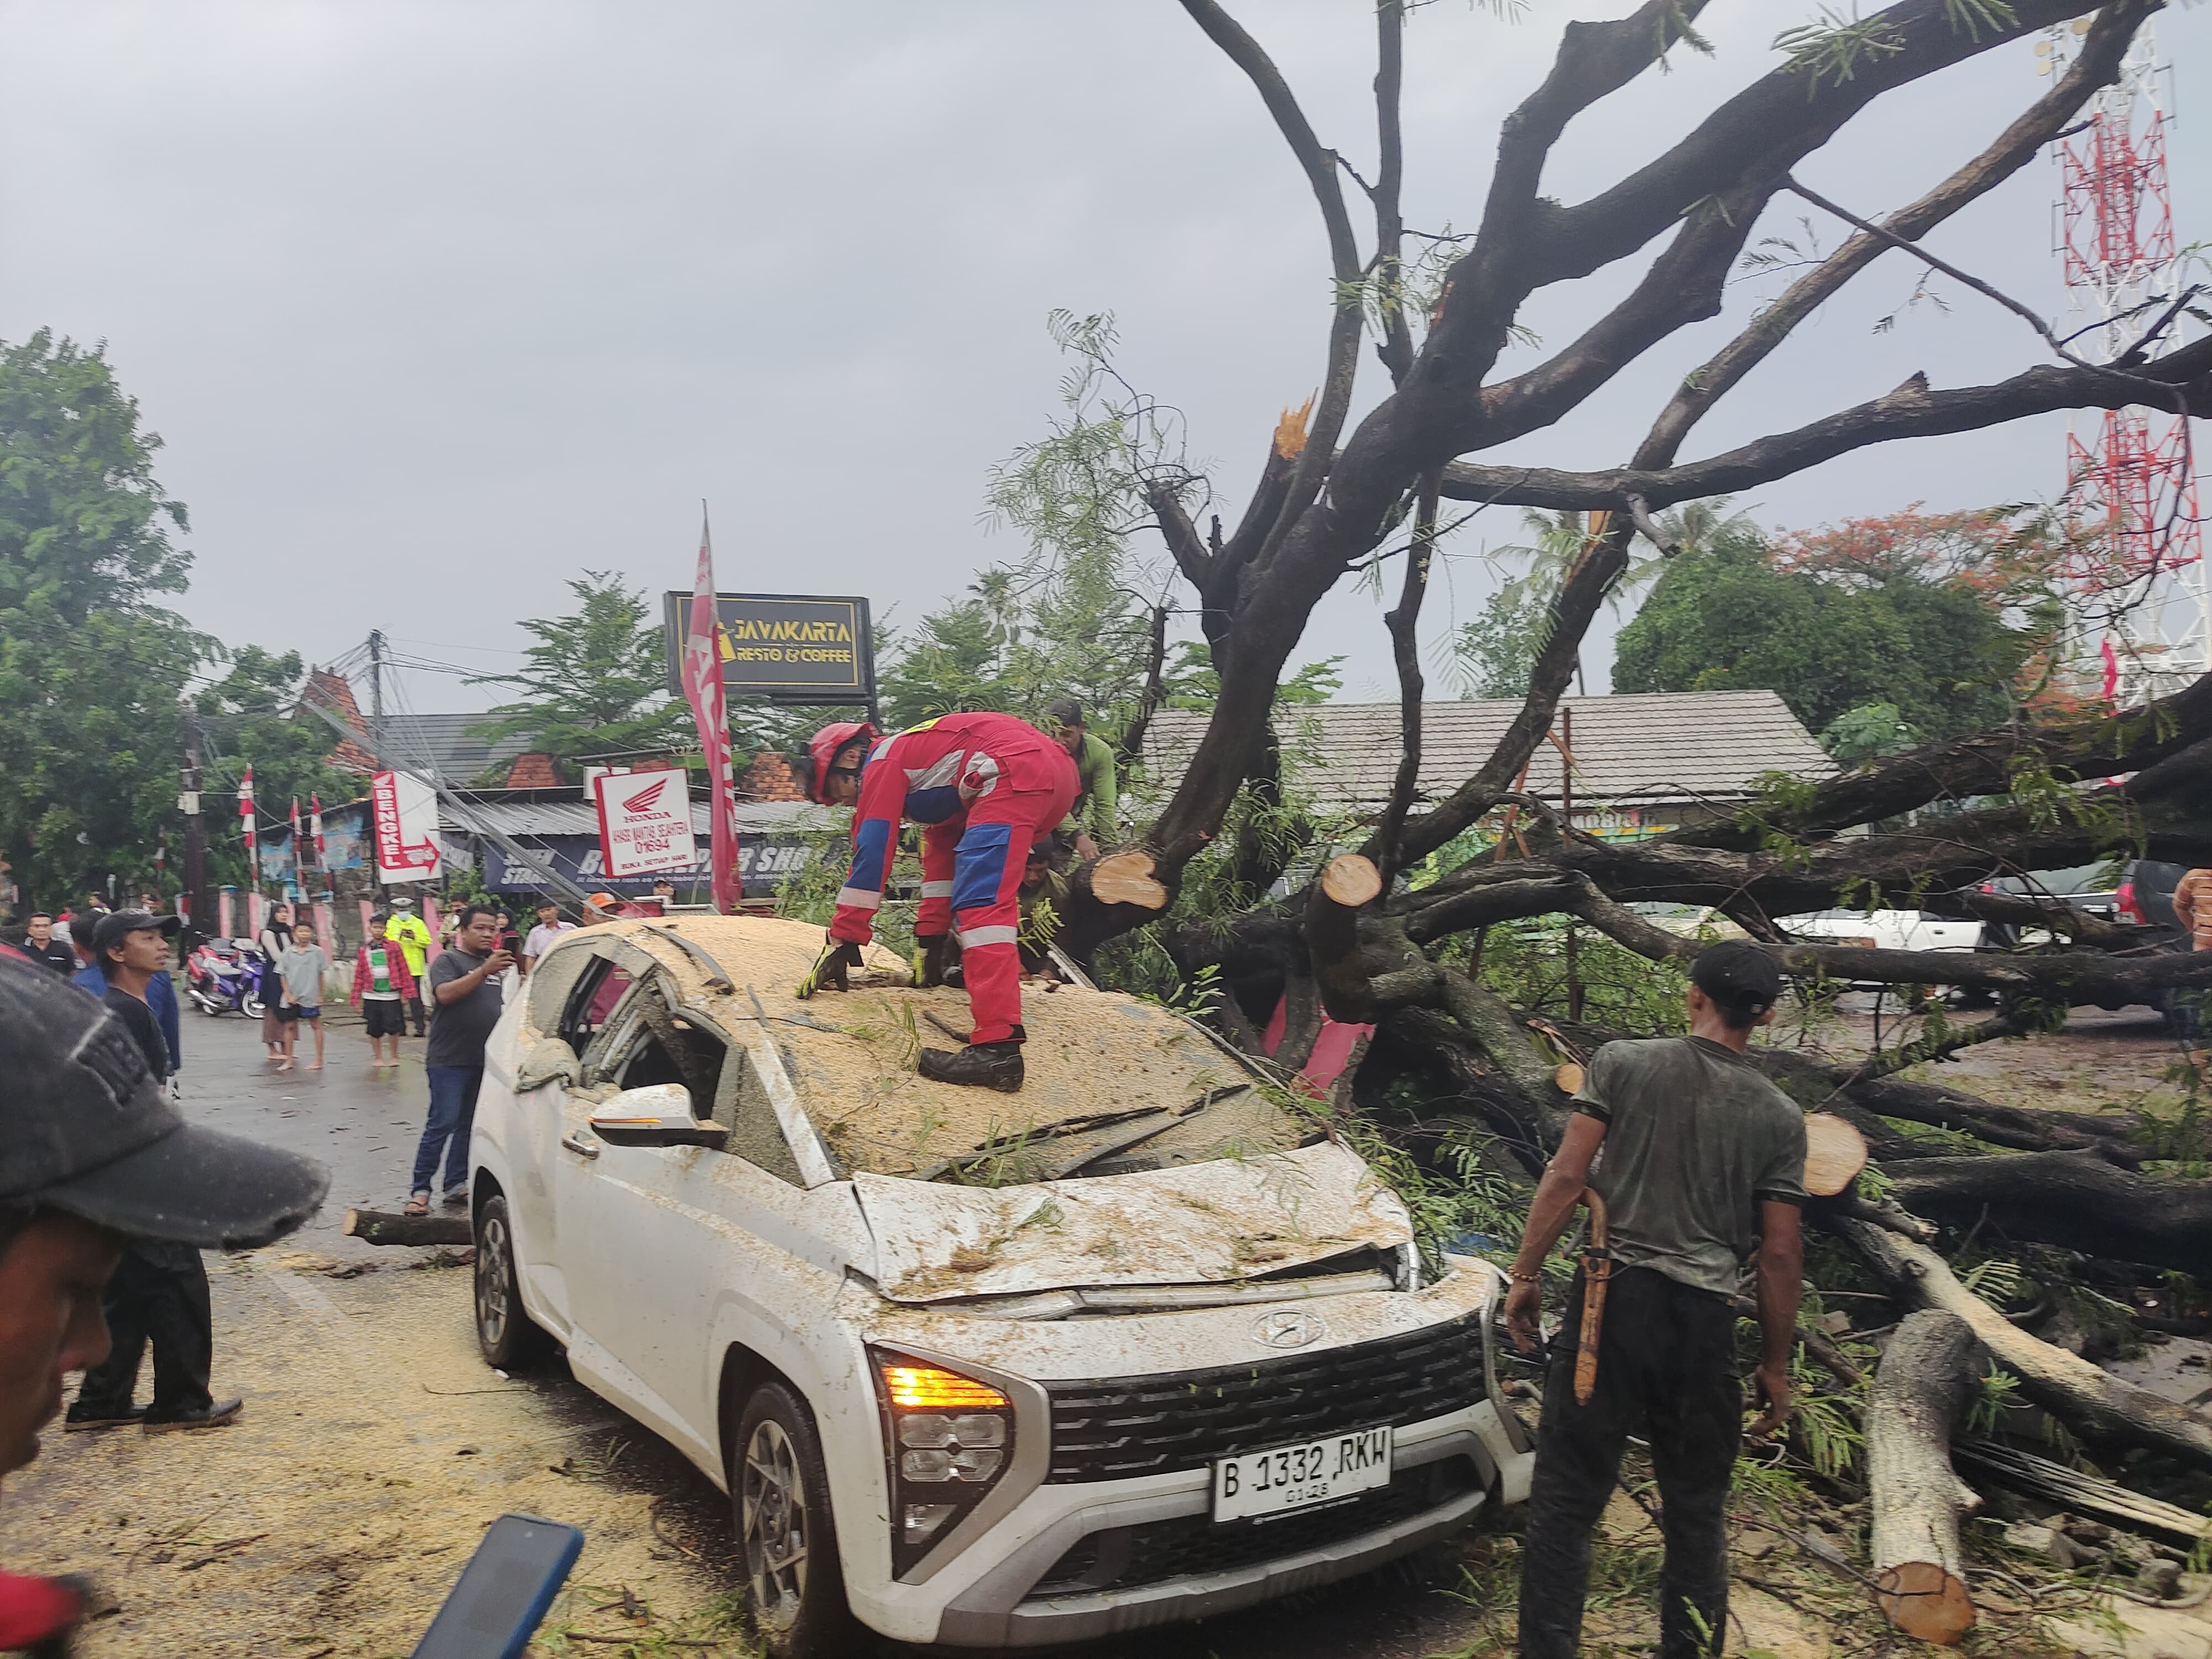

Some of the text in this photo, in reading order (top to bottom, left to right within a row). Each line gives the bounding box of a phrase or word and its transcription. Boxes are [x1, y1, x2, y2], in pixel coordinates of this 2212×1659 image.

[734, 619, 852, 642] JAVAKARTA
[737, 647, 852, 663] RESTO & COFFEE
[623, 812, 672, 823] HONDA
[375, 789, 401, 867] BENGKEL
[636, 838, 670, 854] 01694
[1224, 1462, 1239, 1498] B
[1256, 1446, 1324, 1491] 1332
